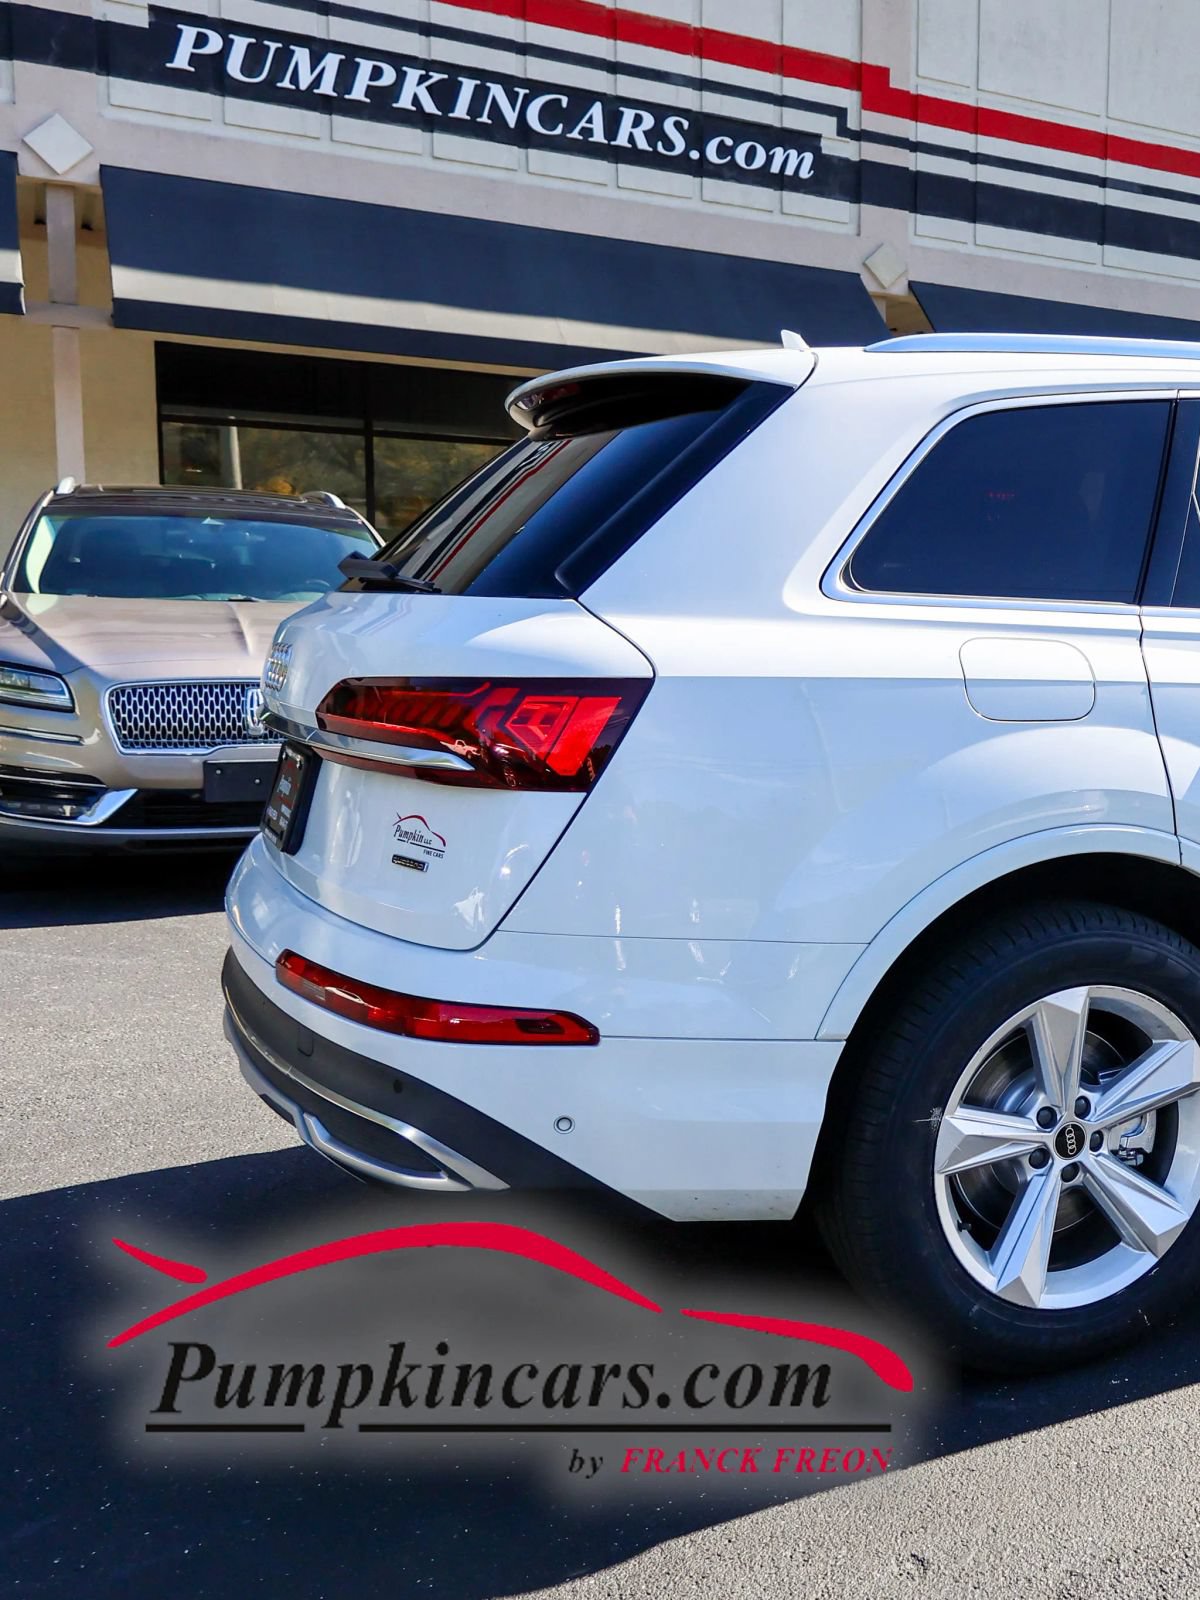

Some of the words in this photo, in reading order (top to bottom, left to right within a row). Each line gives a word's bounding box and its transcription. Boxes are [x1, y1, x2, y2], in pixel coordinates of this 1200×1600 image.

[165, 23, 815, 180] PUMPKINCARS.com
[394, 824, 425, 844] Pumpkin
[423, 849, 433, 857] FINE
[433, 851, 444, 859] CARS
